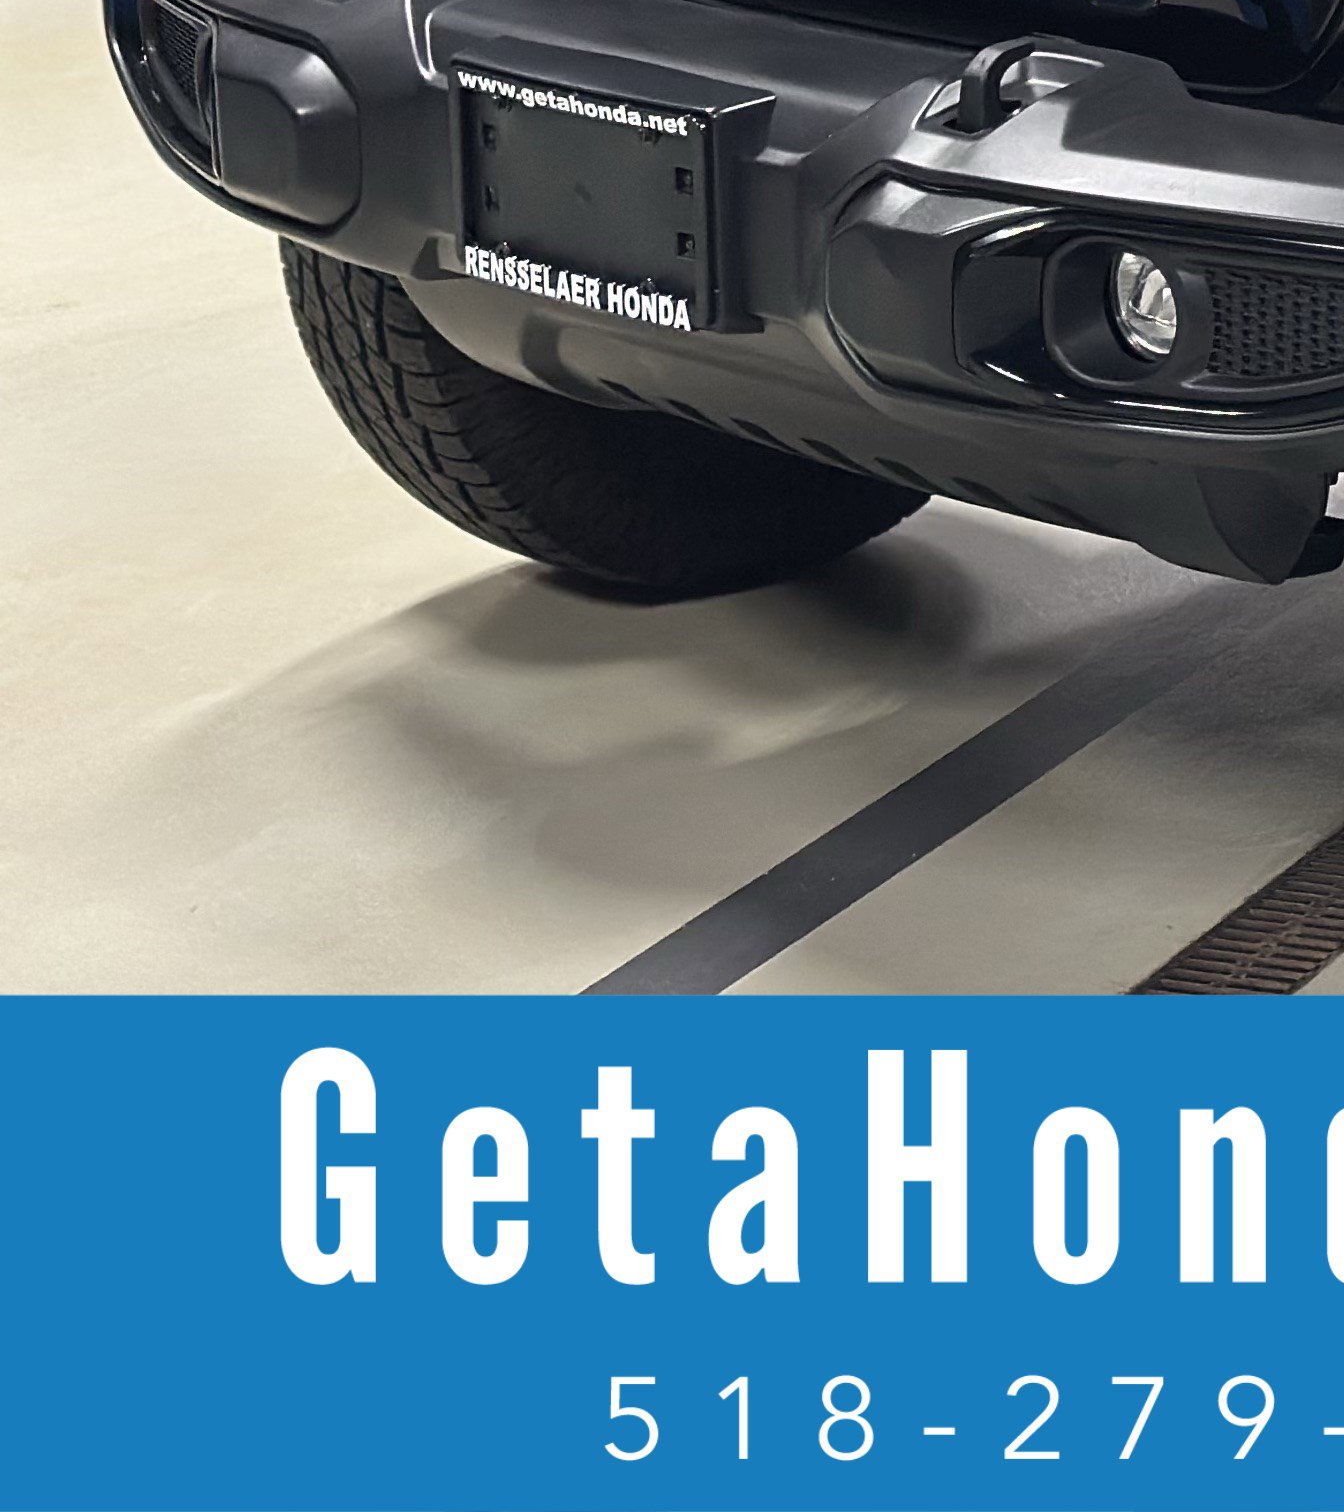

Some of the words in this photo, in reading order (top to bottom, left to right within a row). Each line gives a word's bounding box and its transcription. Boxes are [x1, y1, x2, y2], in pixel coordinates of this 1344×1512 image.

[457, 70, 688, 136] www.getahonda.net
[464, 245, 601, 310] RENSSELAER
[607, 282, 691, 332] HONDA
